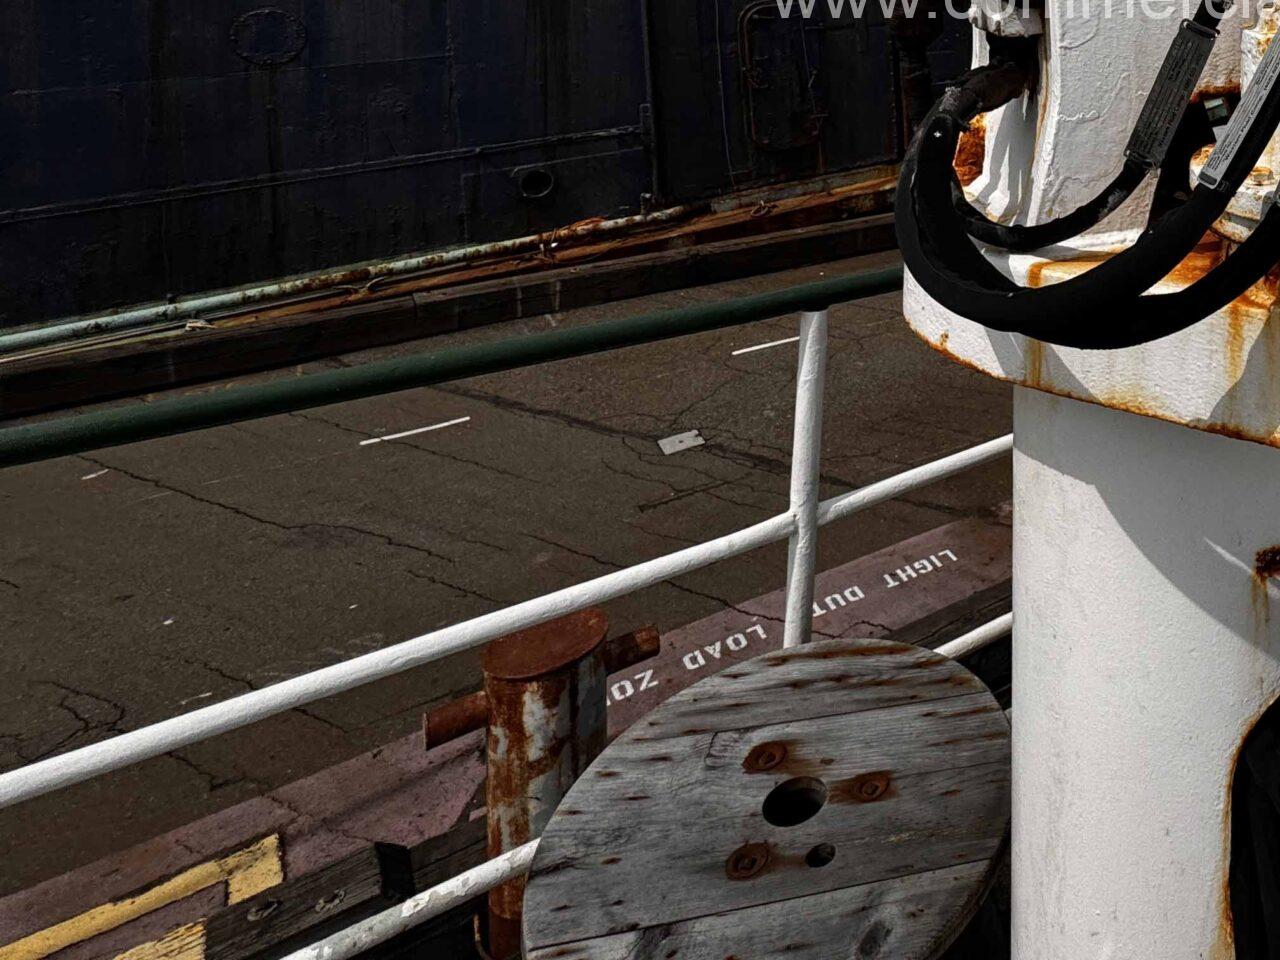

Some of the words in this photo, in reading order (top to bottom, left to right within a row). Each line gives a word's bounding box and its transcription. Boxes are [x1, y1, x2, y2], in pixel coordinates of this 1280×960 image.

[883, 548, 959, 589] LIGHT
[812, 585, 865, 618] DUT
[682, 624, 768, 670] LOAD
[606, 669, 659, 706] ZO
